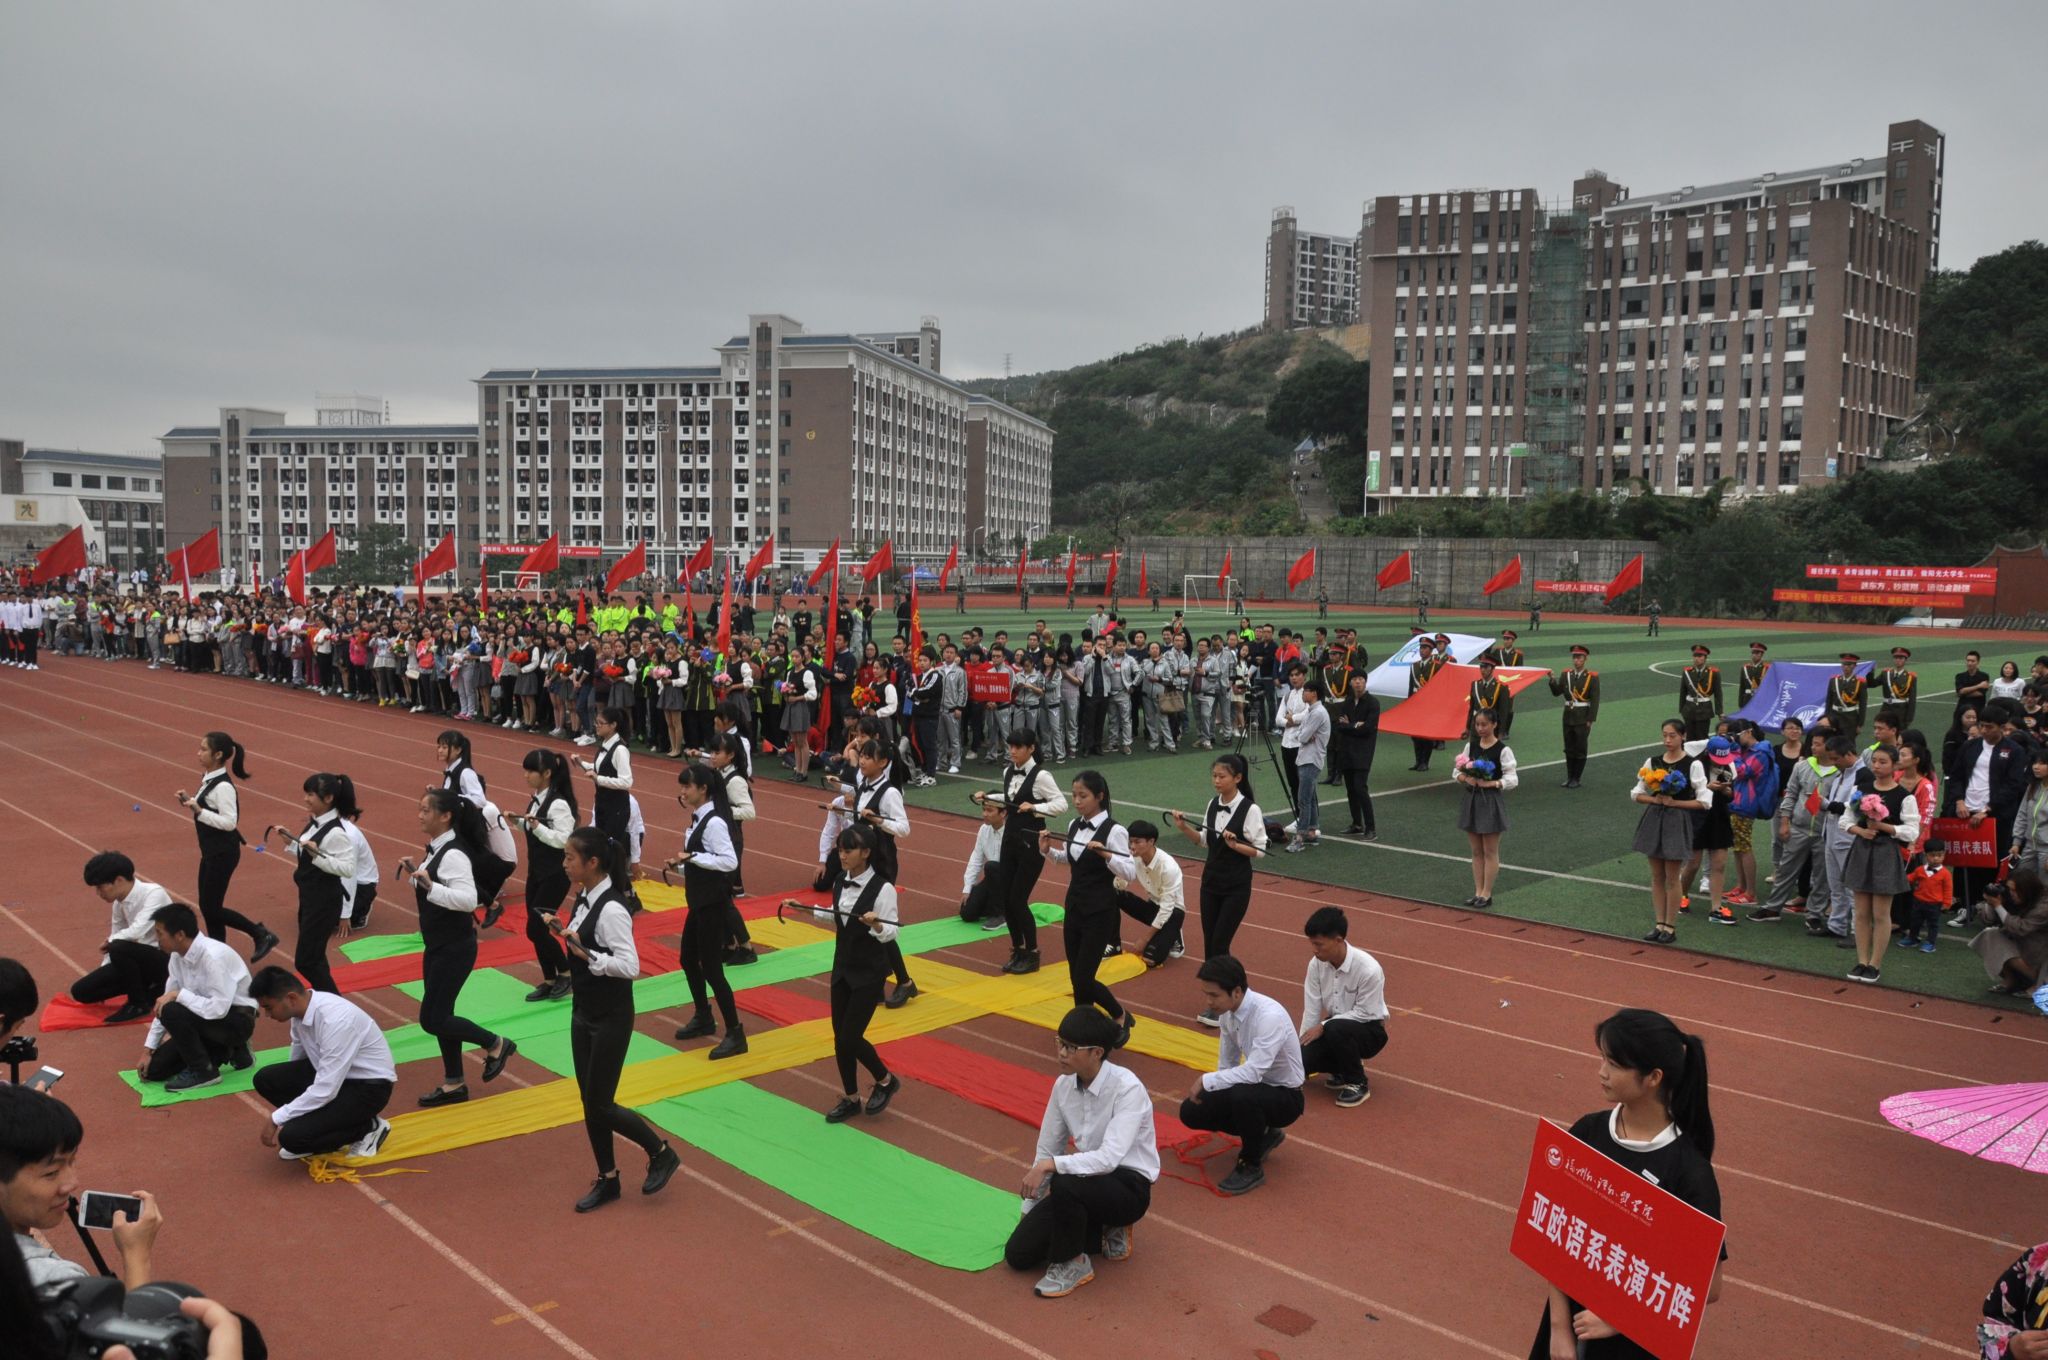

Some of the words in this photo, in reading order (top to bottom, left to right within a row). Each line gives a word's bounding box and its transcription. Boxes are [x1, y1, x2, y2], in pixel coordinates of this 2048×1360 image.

[1944, 840, 1992, 855] 判员代表队
[1527, 1191, 1696, 1329] 亚欧语系表演方阵
